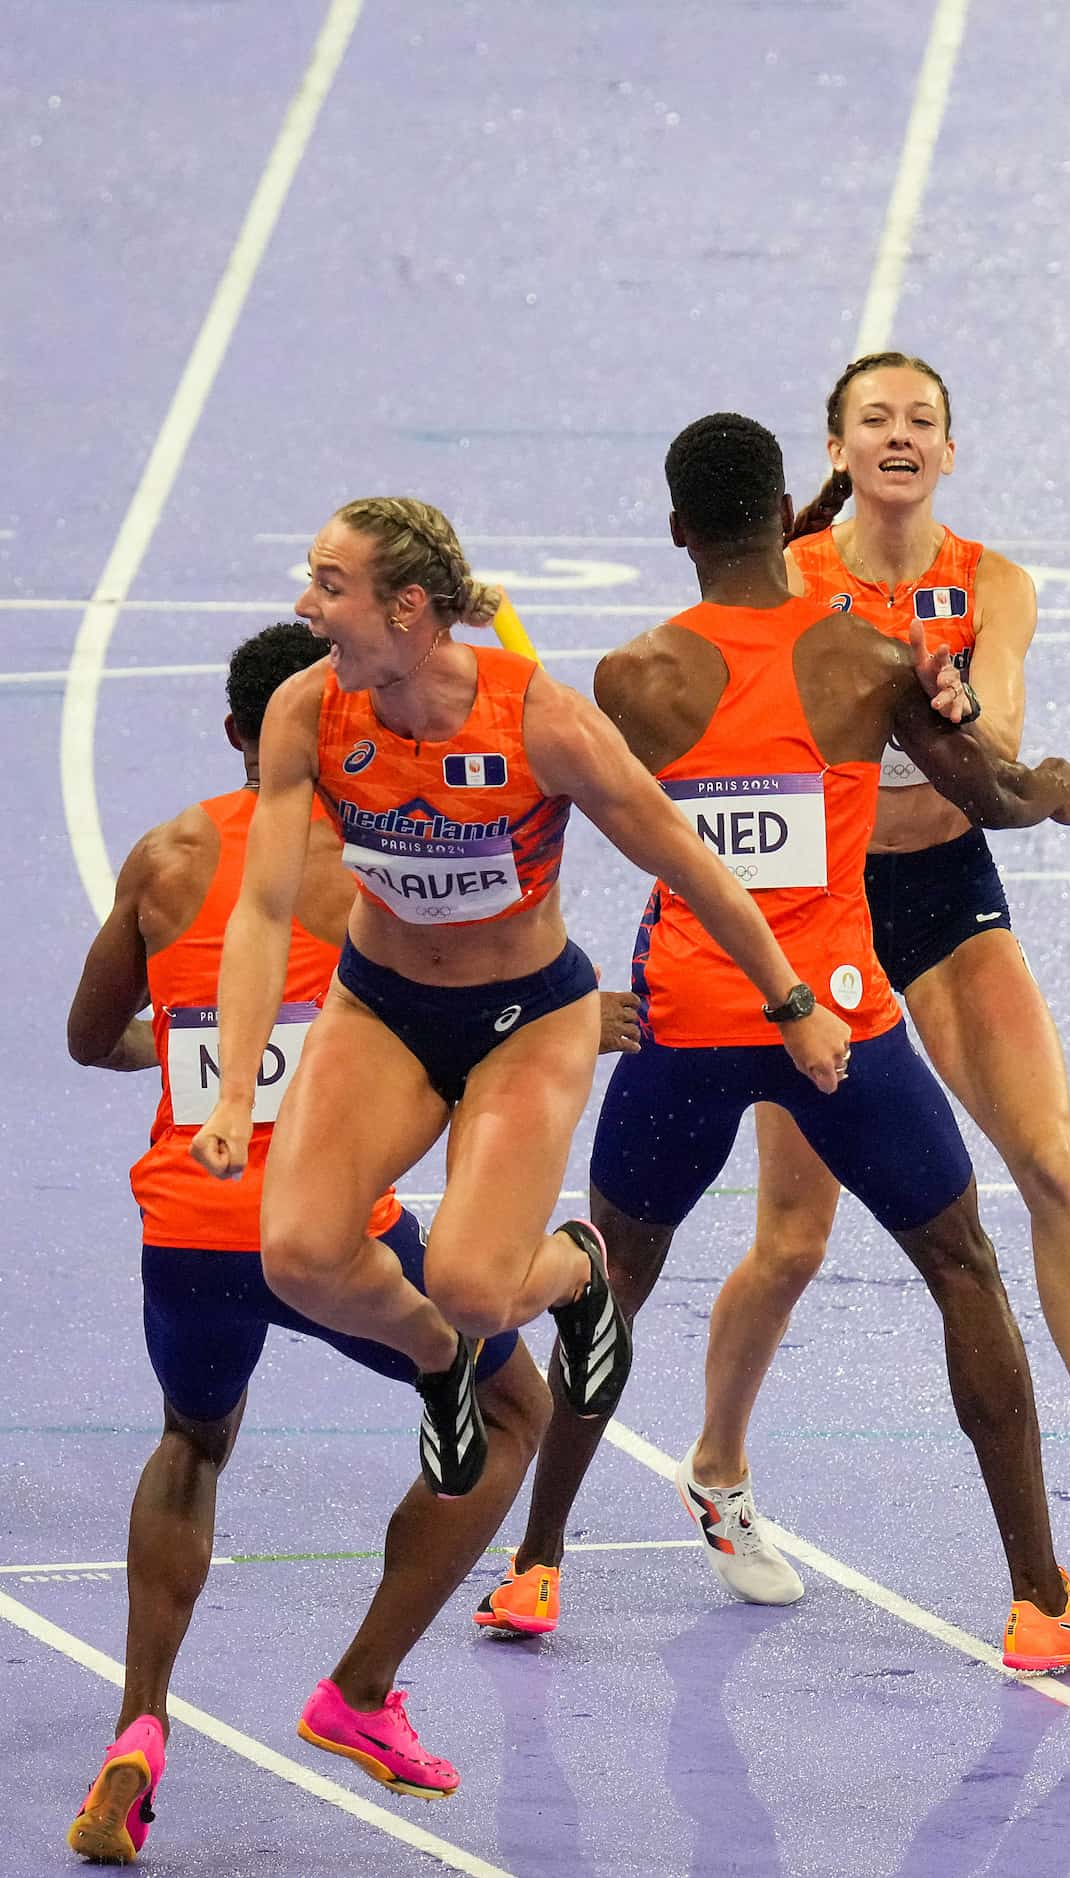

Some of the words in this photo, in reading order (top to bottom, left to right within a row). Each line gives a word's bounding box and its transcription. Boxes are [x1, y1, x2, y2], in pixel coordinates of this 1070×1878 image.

[698, 782, 738, 793] PARIS
[742, 779, 780, 791] 2024
[381, 838, 421, 854] PARIS
[426, 844, 465, 855] 2024
[697, 811, 789, 855] NED
[200, 1042, 286, 1088] ND
